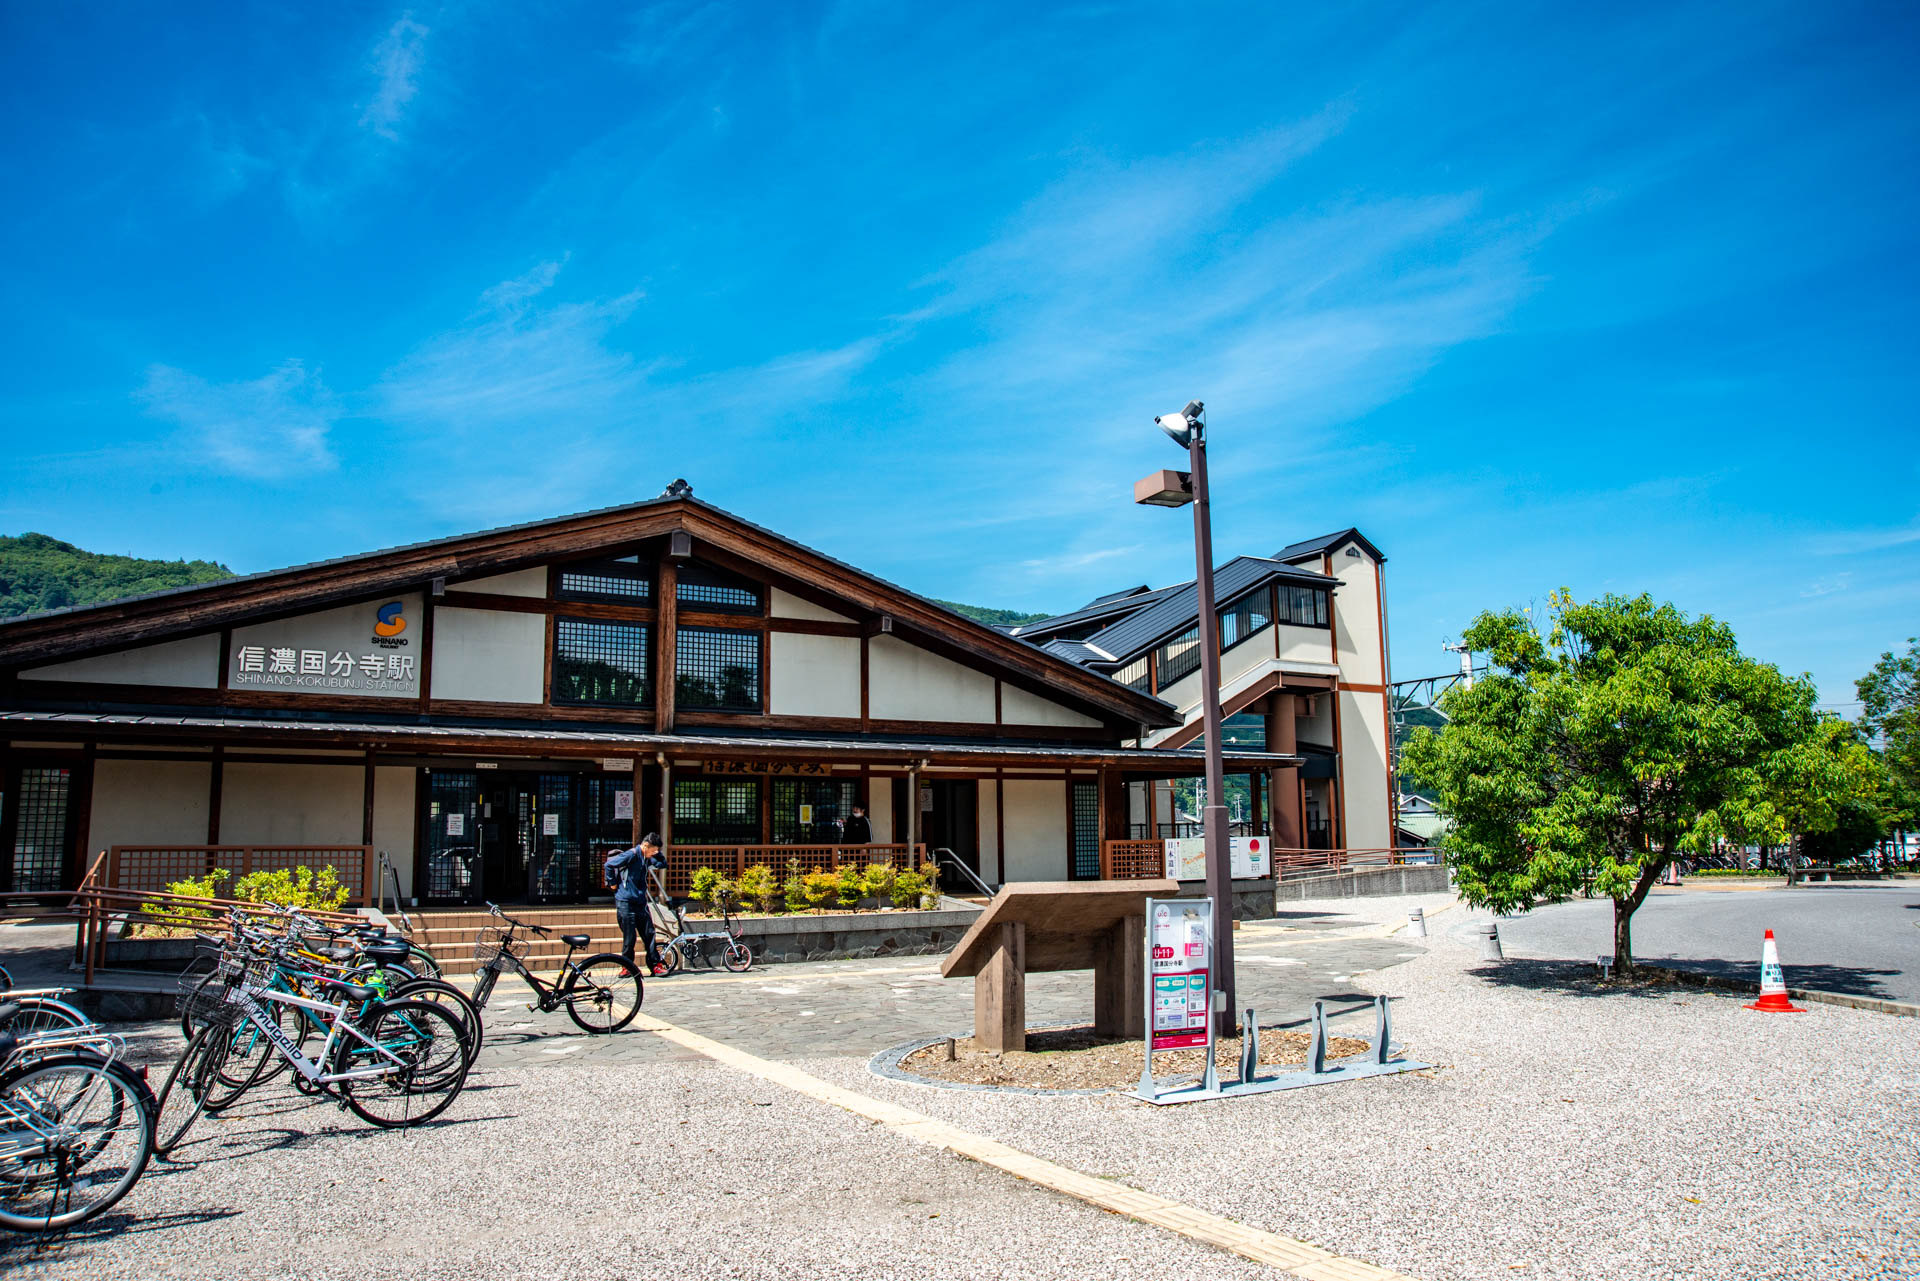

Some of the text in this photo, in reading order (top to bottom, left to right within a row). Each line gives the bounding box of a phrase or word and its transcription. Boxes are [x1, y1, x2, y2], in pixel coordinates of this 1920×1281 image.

[371, 637, 408, 646] SHINANO
[237, 645, 415, 681] 信濃国分寺駅
[236, 672, 415, 692] SHINANO-KOKUBUNJI STATION
[1154, 948, 1170, 958] U-11
[254, 1009, 303, 1060] mugello
